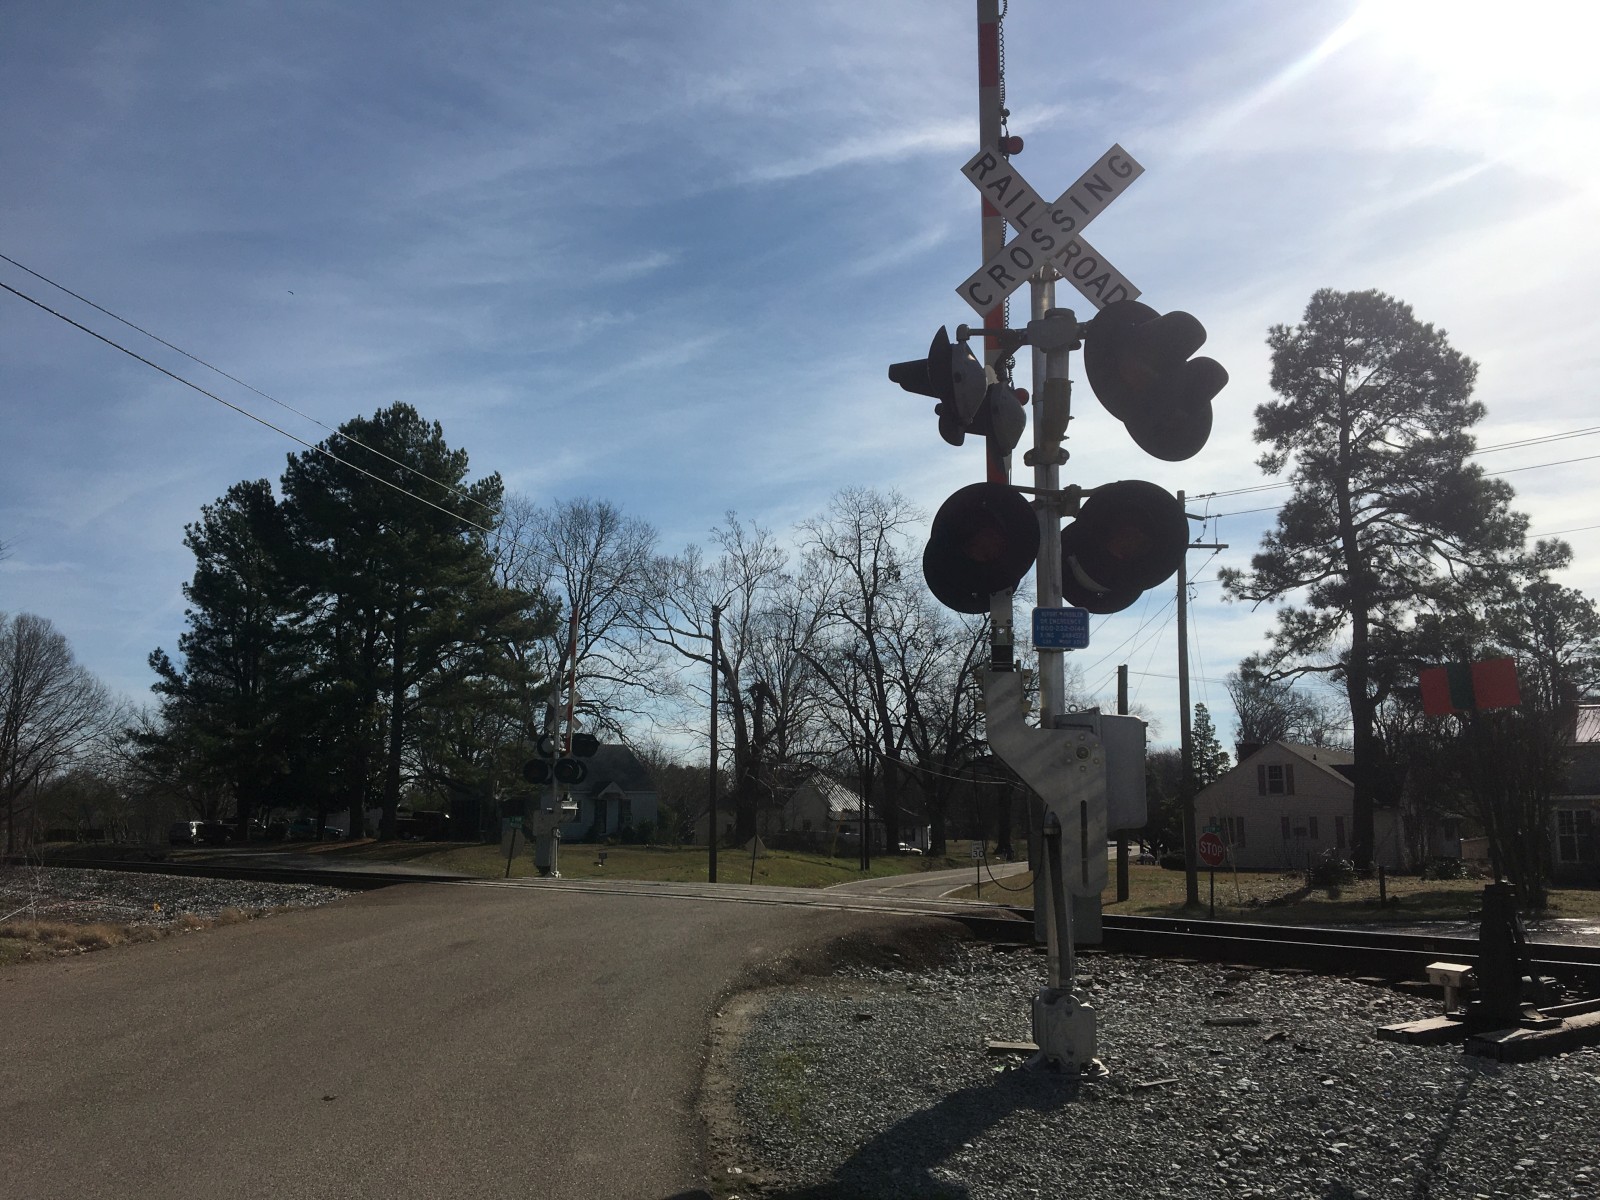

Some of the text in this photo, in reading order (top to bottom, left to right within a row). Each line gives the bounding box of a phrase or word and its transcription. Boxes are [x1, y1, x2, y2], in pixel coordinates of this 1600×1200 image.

[968, 155, 1133, 306] CROSSING
[973, 850, 984, 858] 30
[1201, 841, 1222, 856] STOP
